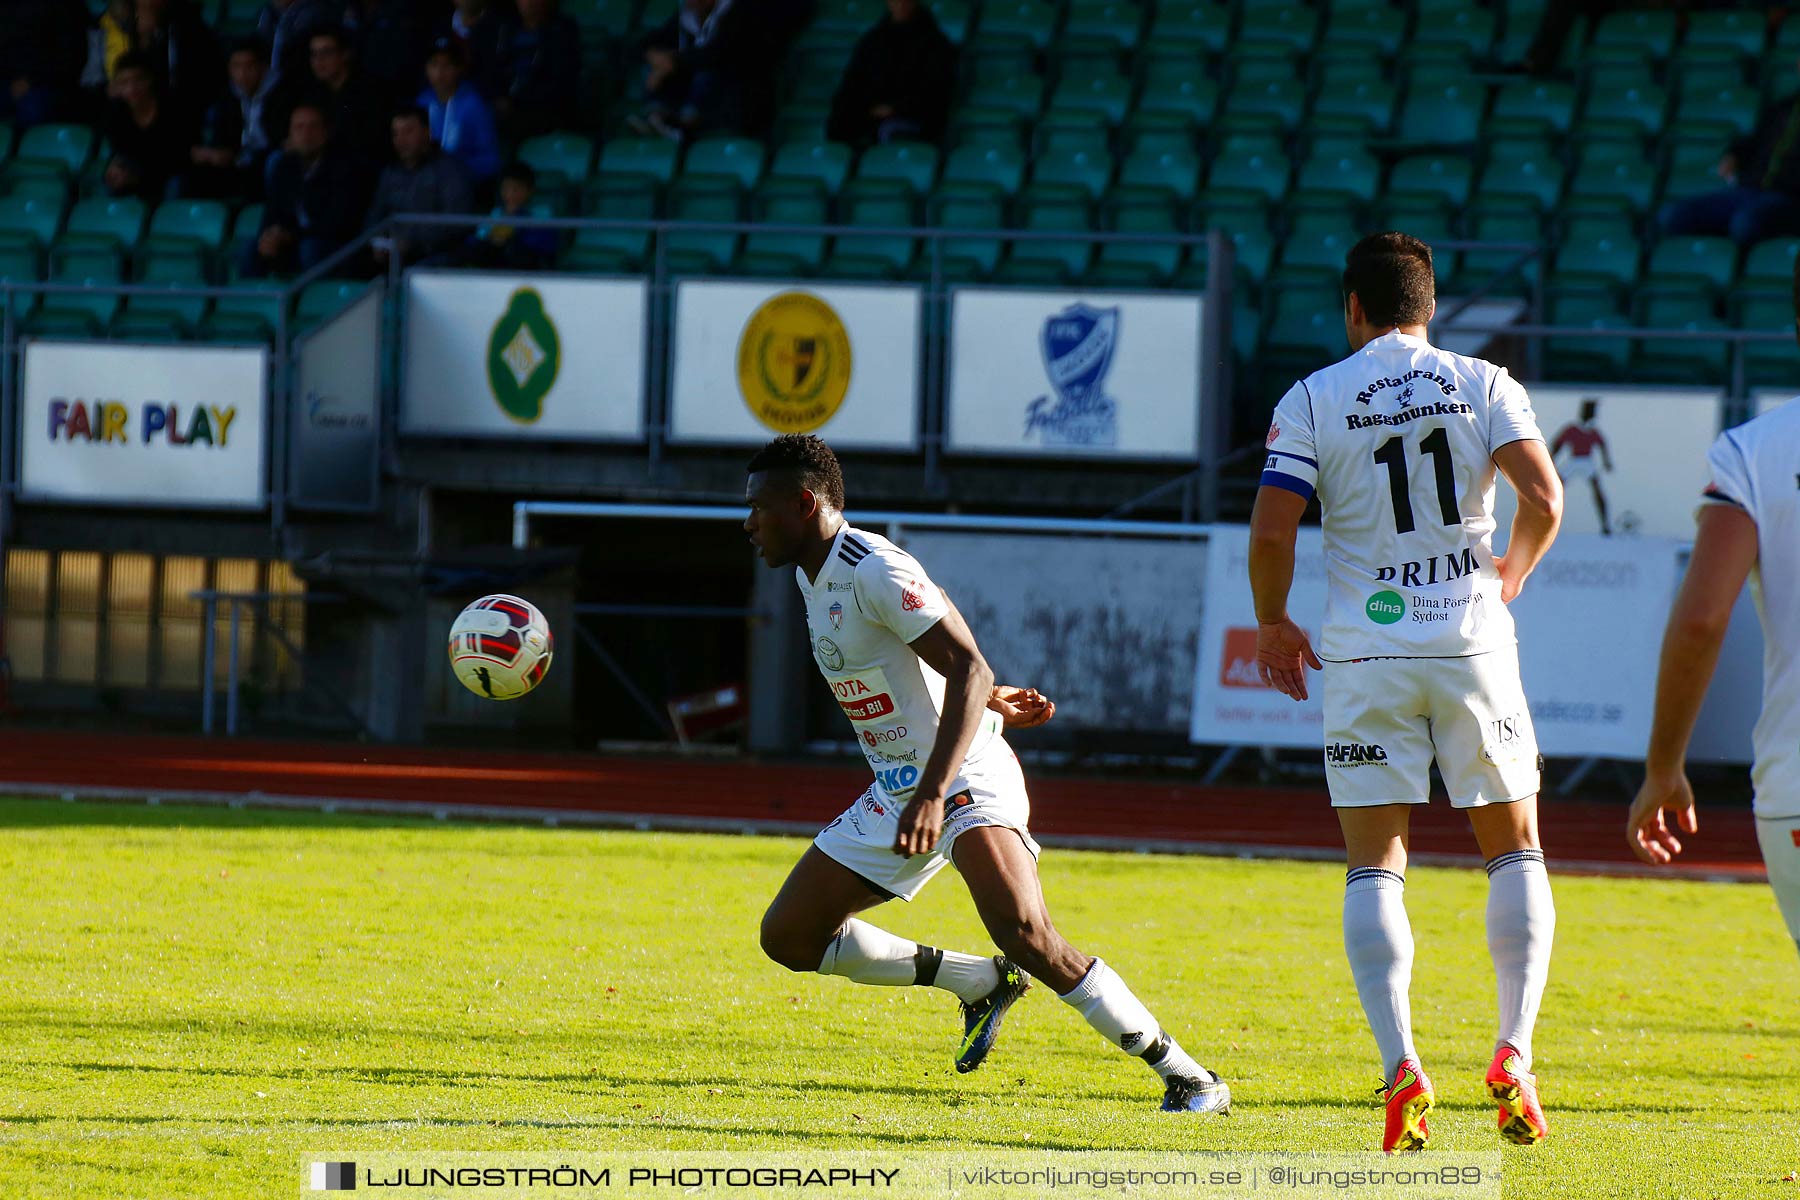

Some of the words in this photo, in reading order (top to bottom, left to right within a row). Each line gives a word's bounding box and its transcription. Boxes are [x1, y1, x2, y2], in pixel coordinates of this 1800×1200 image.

[1356, 369, 1457, 405] Restaurang
[48, 398, 128, 444] FAIR
[142, 402, 236, 446] PLAY
[1345, 402, 1472, 430] Raggmunken
[1373, 427, 1462, 534] 11
[1369, 600, 1402, 614] dina
[1413, 596, 1440, 609] Dina
[1412, 610, 1449, 624] Sydost
[829, 679, 871, 698] YOTA
[866, 699, 884, 715] Bil
[1325, 742, 1388, 762] FÅFÄNG
